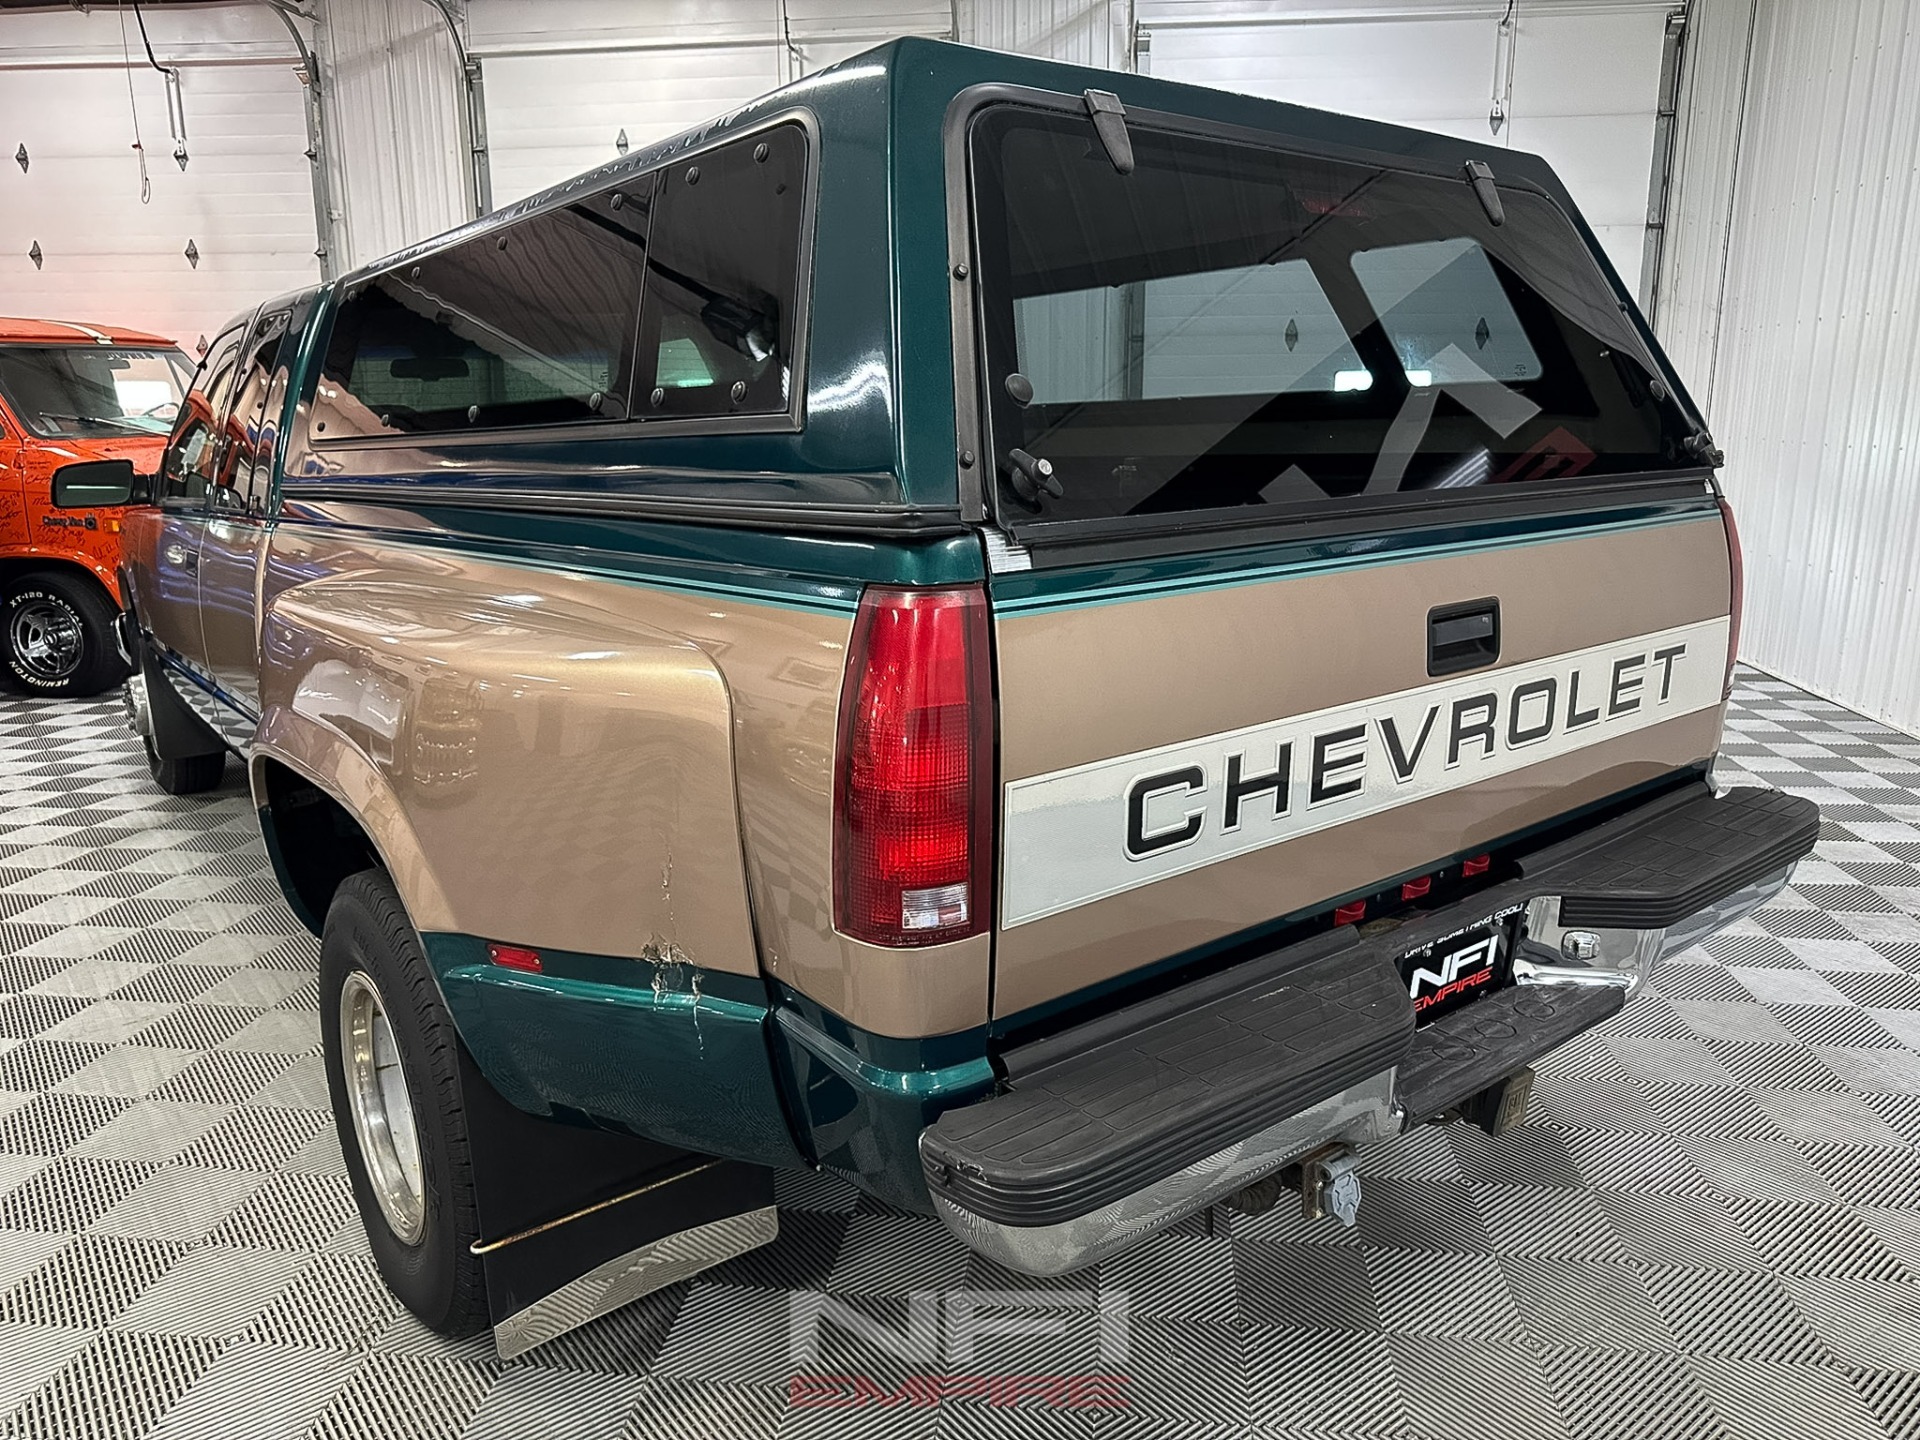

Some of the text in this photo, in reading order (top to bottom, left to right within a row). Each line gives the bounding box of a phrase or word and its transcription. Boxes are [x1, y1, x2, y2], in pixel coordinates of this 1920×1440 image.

[9, 661, 69, 687] REMINGTON
[1124, 643, 1688, 860] CHEVROLET
[1409, 934, 1499, 1000] NFI
[1413, 966, 1493, 1012] EMPIRE
